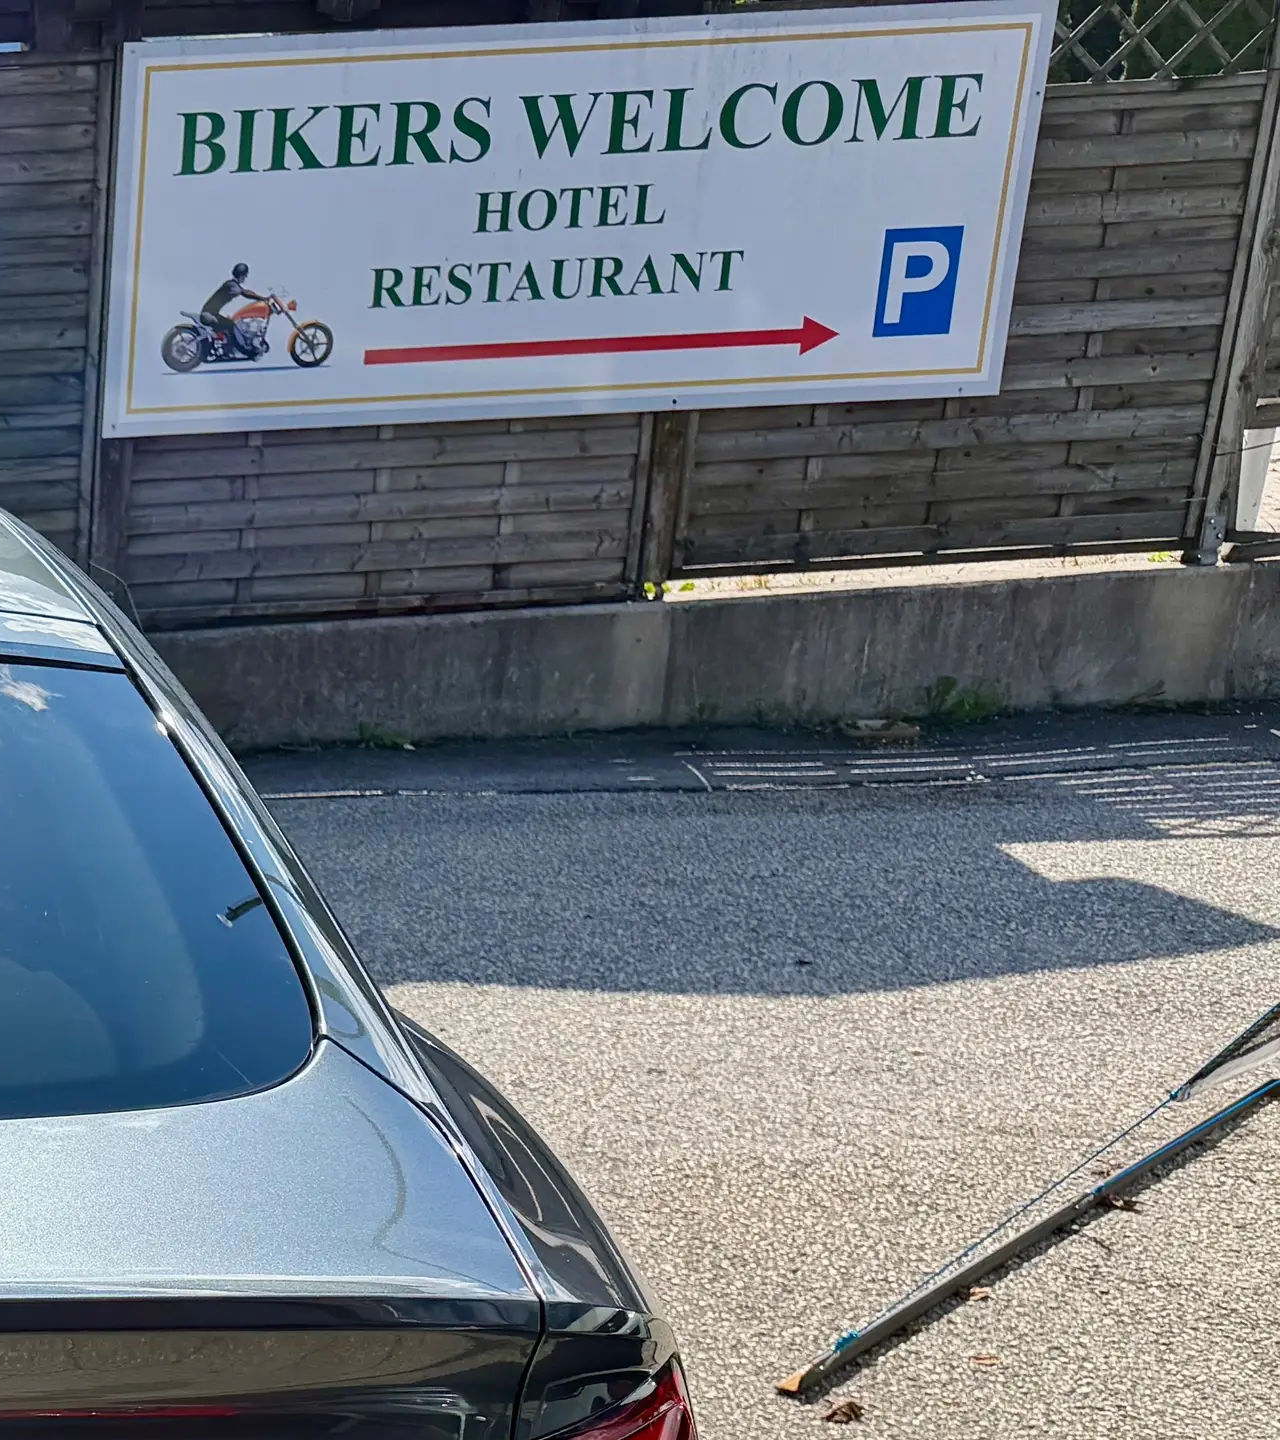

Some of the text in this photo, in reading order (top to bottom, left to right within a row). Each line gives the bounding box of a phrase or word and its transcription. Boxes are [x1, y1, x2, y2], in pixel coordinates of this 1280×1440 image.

[173, 73, 984, 176] BIKERS WELCOME
[472, 184, 666, 234] HOTEL
[368, 250, 744, 309] RESTAURANT
[882, 240, 950, 325] P
